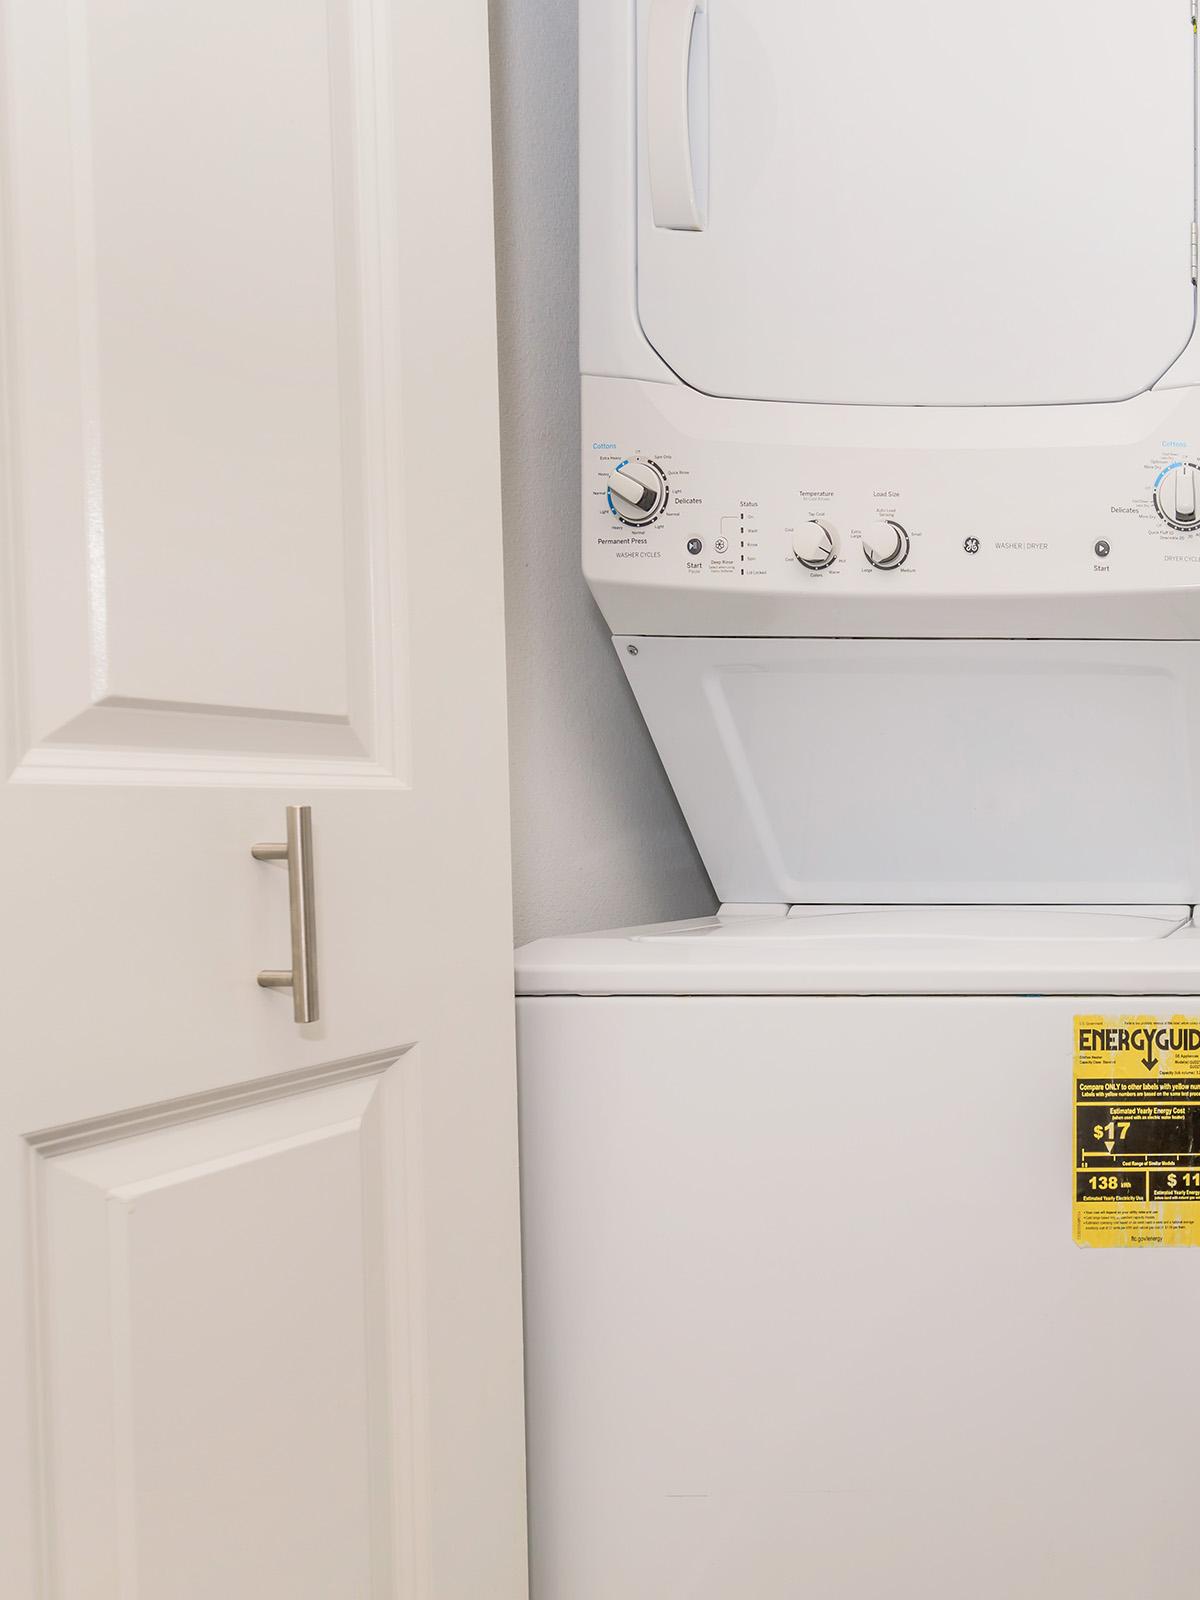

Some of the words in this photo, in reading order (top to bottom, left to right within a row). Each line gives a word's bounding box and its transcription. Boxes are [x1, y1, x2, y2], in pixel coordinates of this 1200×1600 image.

[995, 542, 1022, 550] WASHER
[1027, 542, 1048, 550] DRYER
[1080, 1083, 1104, 1091] Compare
[1105, 1083, 1120, 1091] ONLY
[1121, 1083, 1127, 1091] to
[1128, 1083, 1142, 1091] other
[1143, 1083, 1159, 1091] labels
[1160, 1083, 1171, 1091] with
[1172, 1083, 1189, 1091] yellow
[1110, 1107, 1136, 1115] Estimated
[1137, 1107, 1152, 1115] Yearly
[1154, 1107, 1172, 1115] Energy
[1173, 1107, 1185, 1115] Cost
[1094, 1122, 1130, 1140] $17
[1089, 1176, 1118, 1190] 138
[1167, 1173, 1177, 1188] $
[1182, 1173, 1200, 1186] 11
